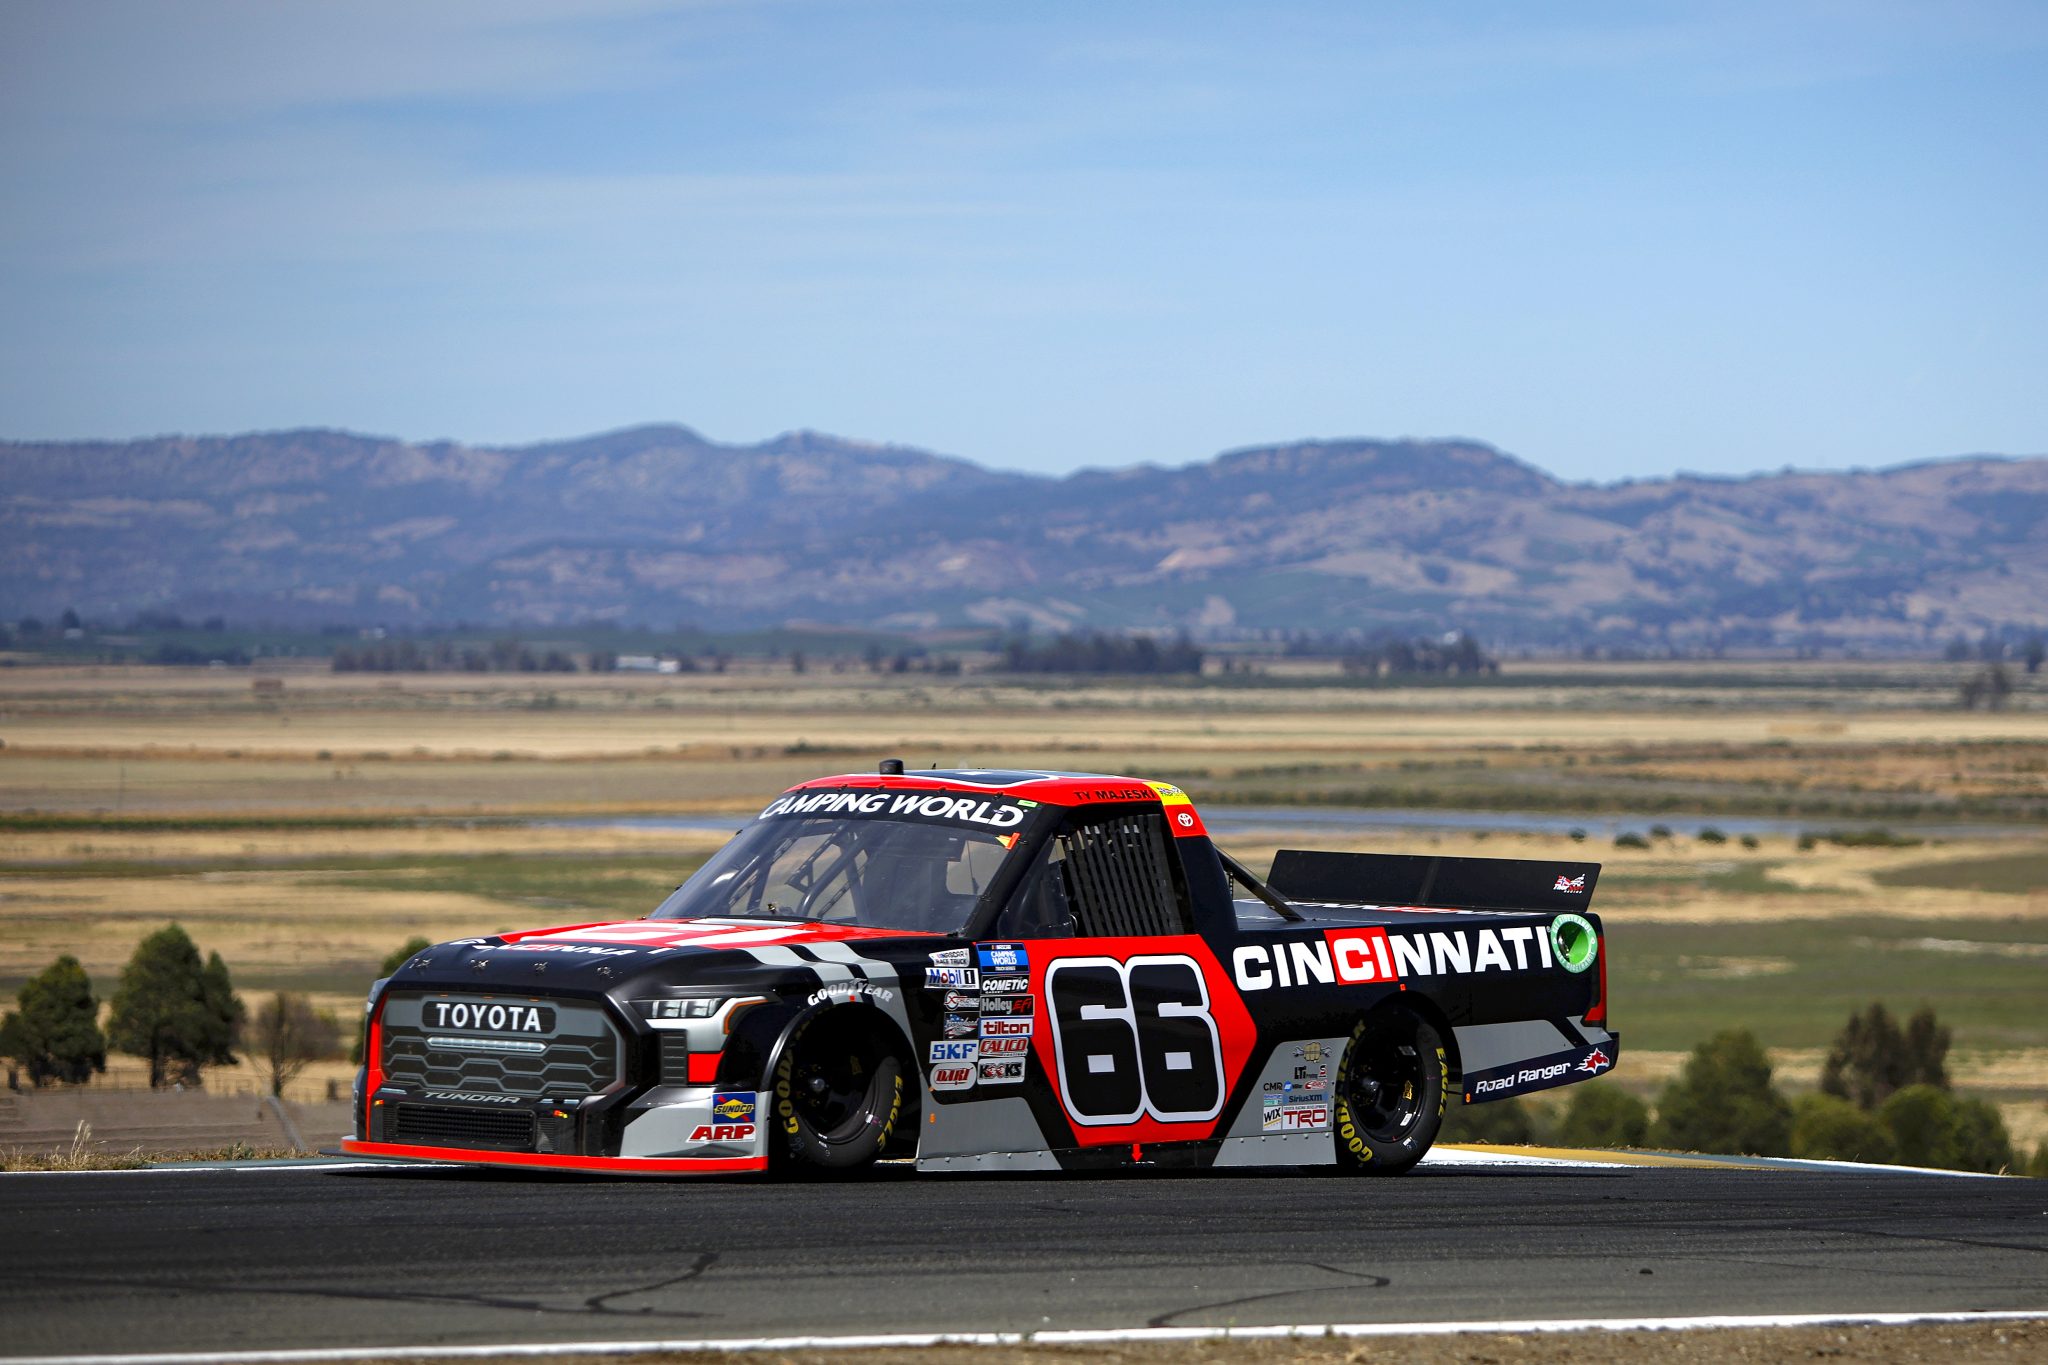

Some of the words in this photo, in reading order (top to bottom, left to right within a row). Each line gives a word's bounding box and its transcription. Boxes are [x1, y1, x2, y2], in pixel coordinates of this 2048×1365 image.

[1074, 791, 1092, 800] TY
[1095, 789, 1156, 800] MAJESKI
[759, 793, 891, 820] CAMPING
[889, 797, 1025, 827] WORLD
[992, 957, 1017, 965] WORLD
[1232, 926, 1553, 992] CINCINNATI
[929, 969, 962, 985] Mobil
[966, 970, 974, 985] 1
[982, 978, 1029, 991] COMETIC
[981, 997, 1013, 1015] Holley
[436, 1003, 542, 1033] TOYOTA
[984, 1021, 1030, 1035] tilton
[981, 1039, 1028, 1053] CALICO
[1045, 955, 1226, 1126] 66
[931, 1043, 977, 1060] SKF
[1263, 1082, 1283, 1091] CMR
[1475, 1075, 1515, 1094] Road
[1517, 1063, 1571, 1084] Ranger
[424, 1091, 521, 1104] TUNDRA
[716, 1104, 754, 1114] SUNOCO
[877, 1074, 904, 1152] EAGLE
[1263, 1107, 1281, 1123] WIX
[1283, 1108, 1327, 1128] TRD
[690, 1125, 755, 1140] ARP
